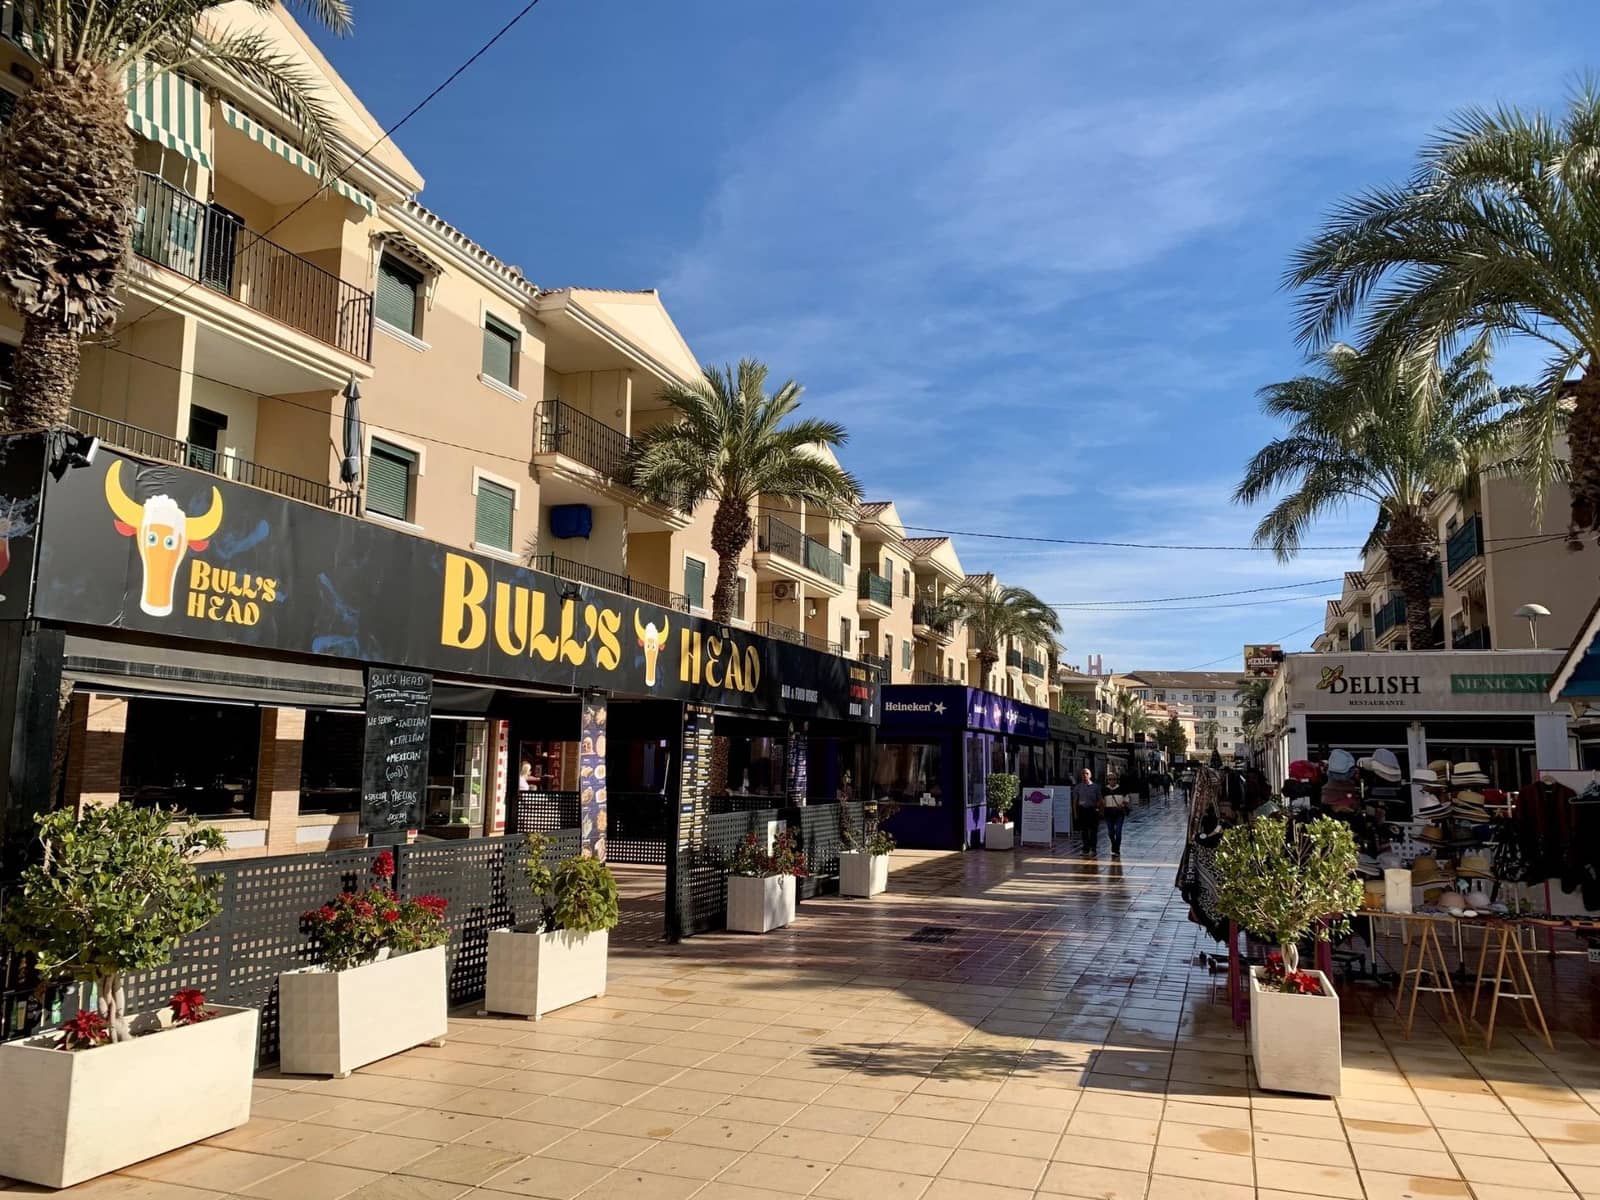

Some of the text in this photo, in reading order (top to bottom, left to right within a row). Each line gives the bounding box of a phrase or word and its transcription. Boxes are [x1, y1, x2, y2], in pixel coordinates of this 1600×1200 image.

[190, 559, 277, 602] BULL'S
[187, 591, 260, 626] HEAD
[441, 552, 760, 693] BULL'S HEAD
[400, 674, 424, 687] HEAD
[1329, 675, 1421, 694] DELISH
[1457, 678, 1537, 689] MEXICAN
[885, 701, 931, 712] Heineken
